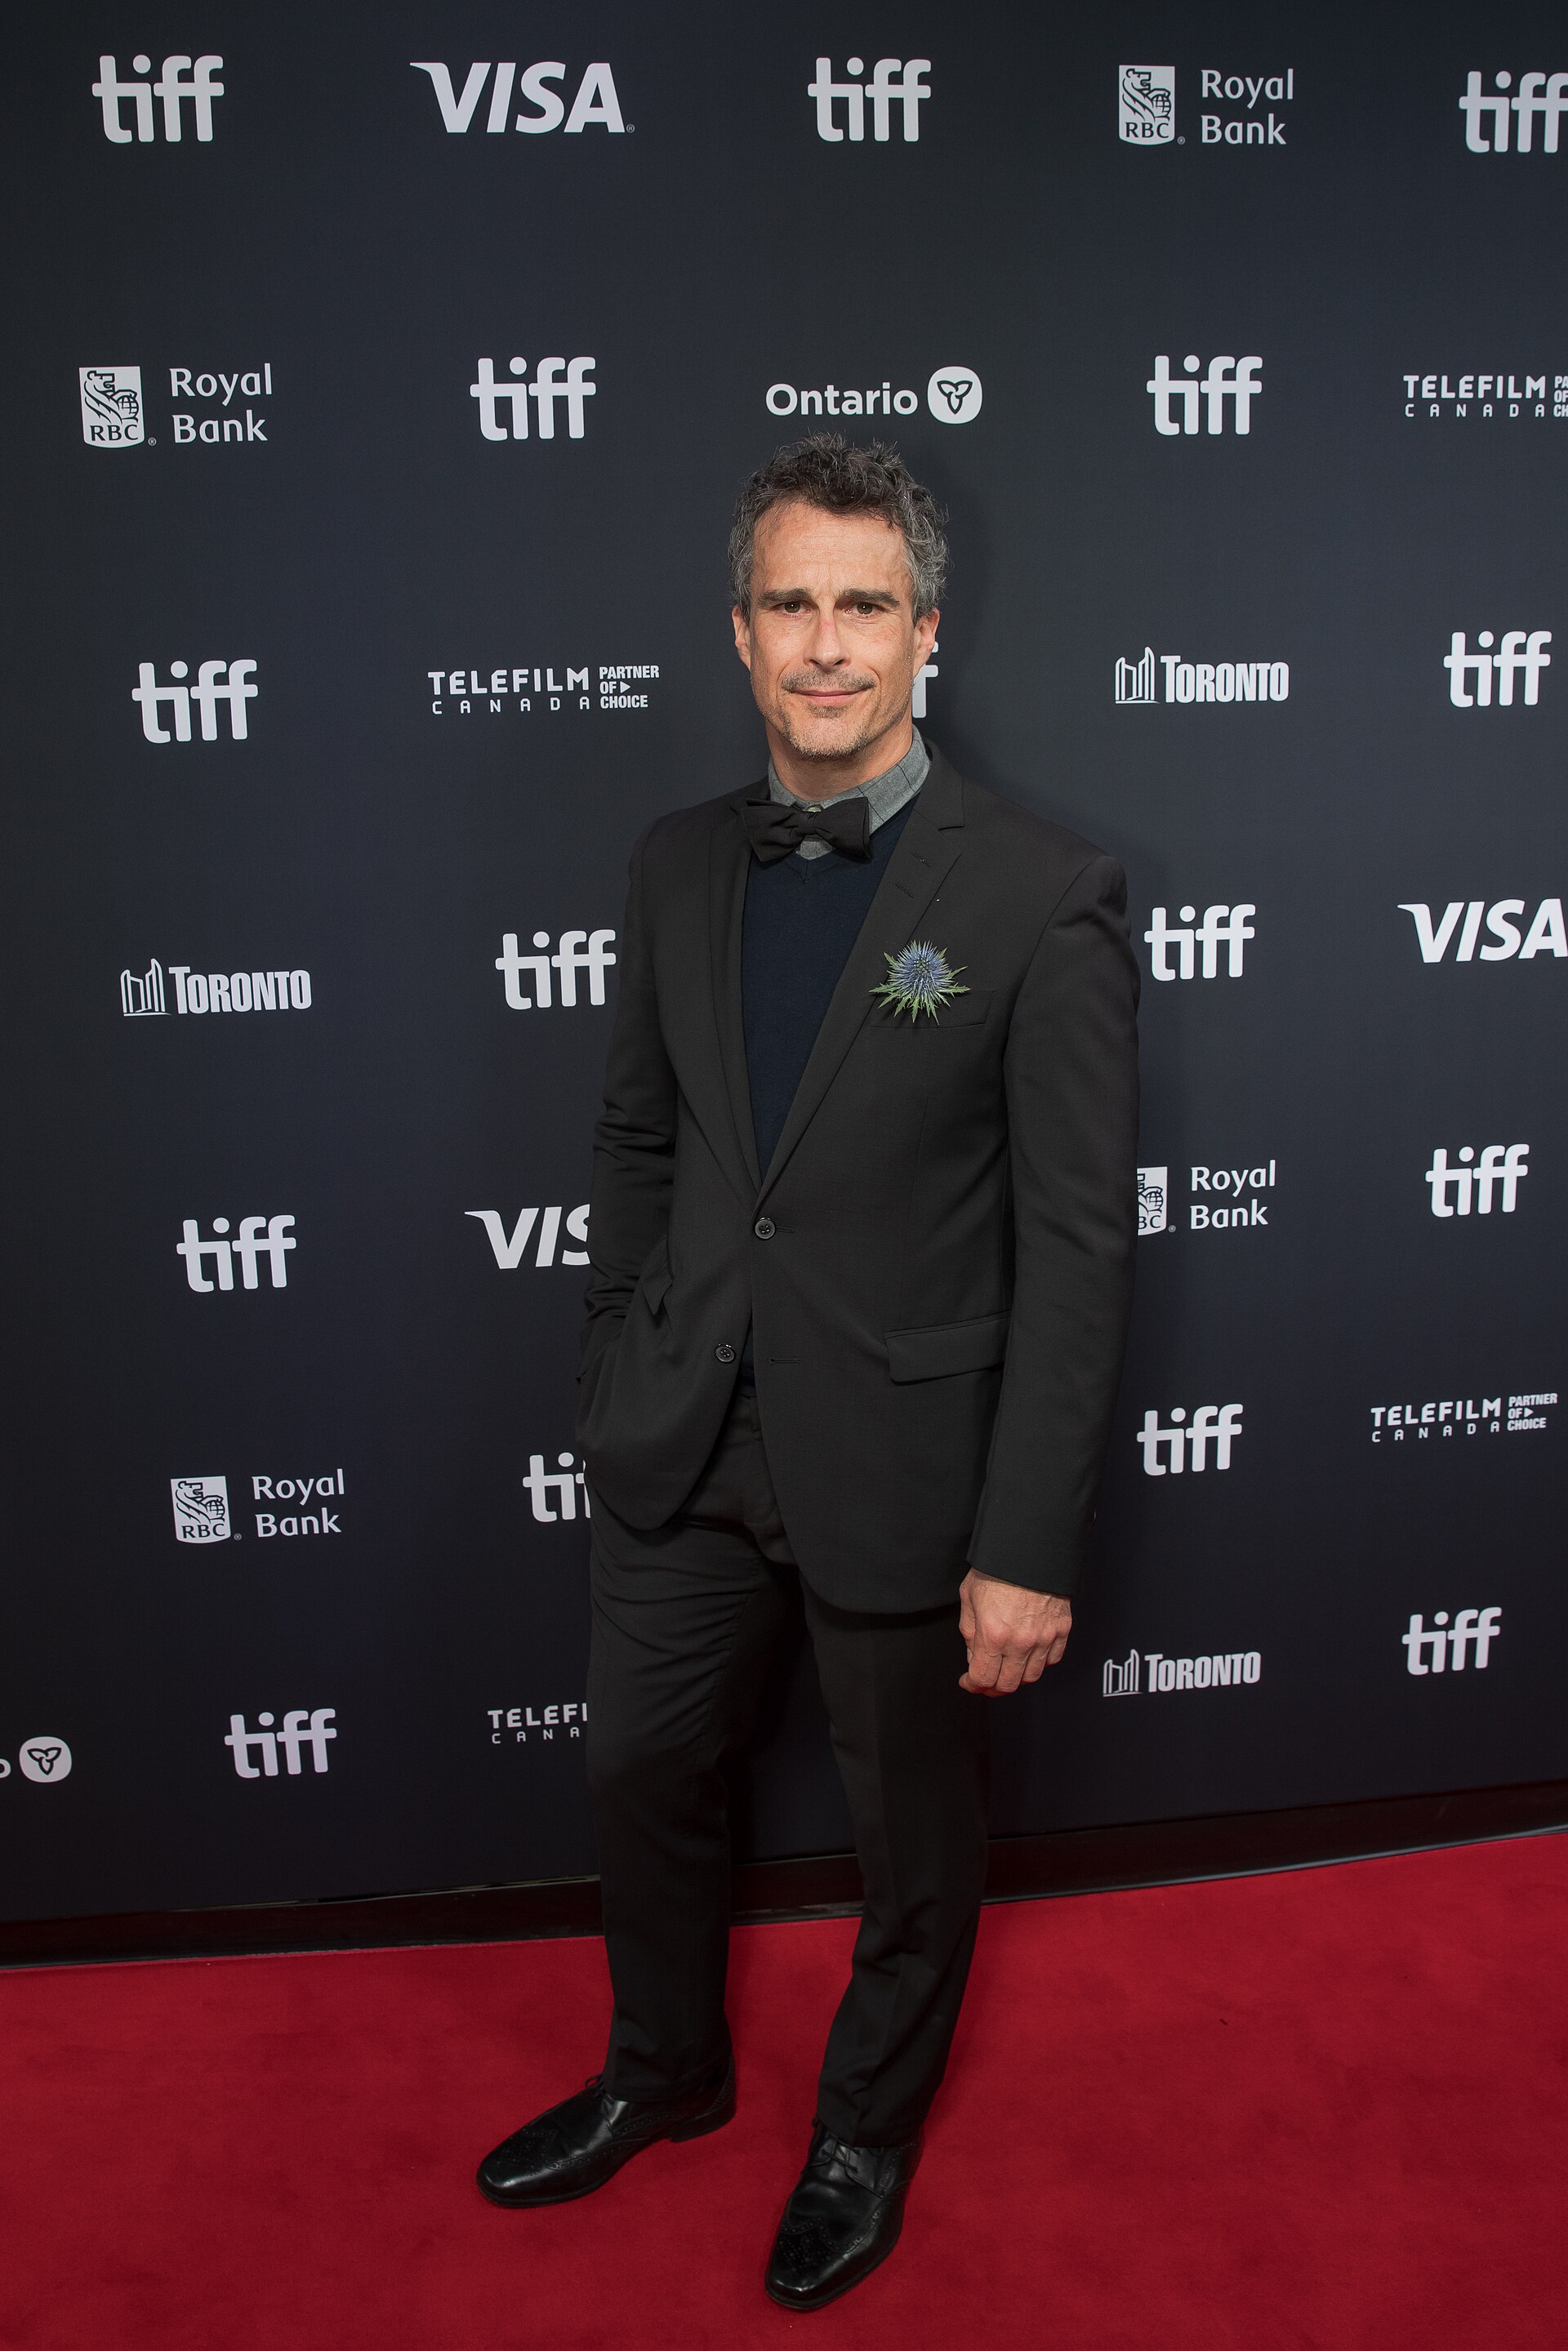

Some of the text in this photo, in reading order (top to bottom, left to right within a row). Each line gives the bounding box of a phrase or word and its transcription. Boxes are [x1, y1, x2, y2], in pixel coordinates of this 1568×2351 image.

[92, 55, 224, 143] tiff
[410, 61, 626, 134] VISA
[808, 57, 931, 141] tiff
[1201, 69, 1293, 109] Royal
[1125, 122, 1169, 138] RBC
[1201, 114, 1286, 145] Bank
[1459, 71, 1568, 153] tiff
[169, 363, 272, 406] Royal
[470, 357, 596, 441] tiff
[766, 382, 919, 416] Ontario
[1147, 355, 1263, 435] tiff
[1403, 375, 1546, 399] TELEFILM
[172, 410, 268, 443] Bank
[1405, 403, 1545, 417] CANADA
[91, 425, 139, 441] RBC
[428, 667, 589, 695] TELEFILM
[599, 666, 659, 679] PARTNER
[599, 681, 617, 694] OF
[1160, 655, 1290, 703] TORONTO
[1444, 631, 1552, 707] tiff
[131, 660, 258, 743] tiff
[432, 697, 590, 715] CANADA
[600, 695, 648, 709] CHOICE
[1144, 904, 1256, 982] tiff
[1397, 898, 1568, 964] VISA
[496, 929, 617, 1010] tiff
[168, 966, 312, 1014] TORONTO
[1191, 1160, 1276, 1197] Royal
[1425, 1144, 1530, 1218] tiff
[1138, 1214, 1161, 1230] BC
[1190, 1199, 1268, 1230] Bank
[176, 1215, 296, 1292] tiff
[465, 1204, 590, 1269] VIS
[1370, 1397, 1501, 1427] TELEFILM
[1508, 1393, 1557, 1407] PARTNER
[1508, 1408, 1522, 1419] OF
[1137, 1404, 1243, 1476] tiff
[1372, 1421, 1499, 1442] CANADA
[1507, 1418, 1547, 1432] CHOICE
[252, 1469, 345, 1506] Royal
[523, 1452, 591, 1522] ti
[181, 1523, 225, 1538] RBC
[255, 1507, 341, 1538] Bank
[1402, 1607, 1502, 1675] tiff
[1144, 1651, 1262, 1693] TORONTO
[488, 1703, 588, 1729] TELEFI
[225, 1708, 336, 1778] tiff
[492, 1726, 580, 1744] CANA
